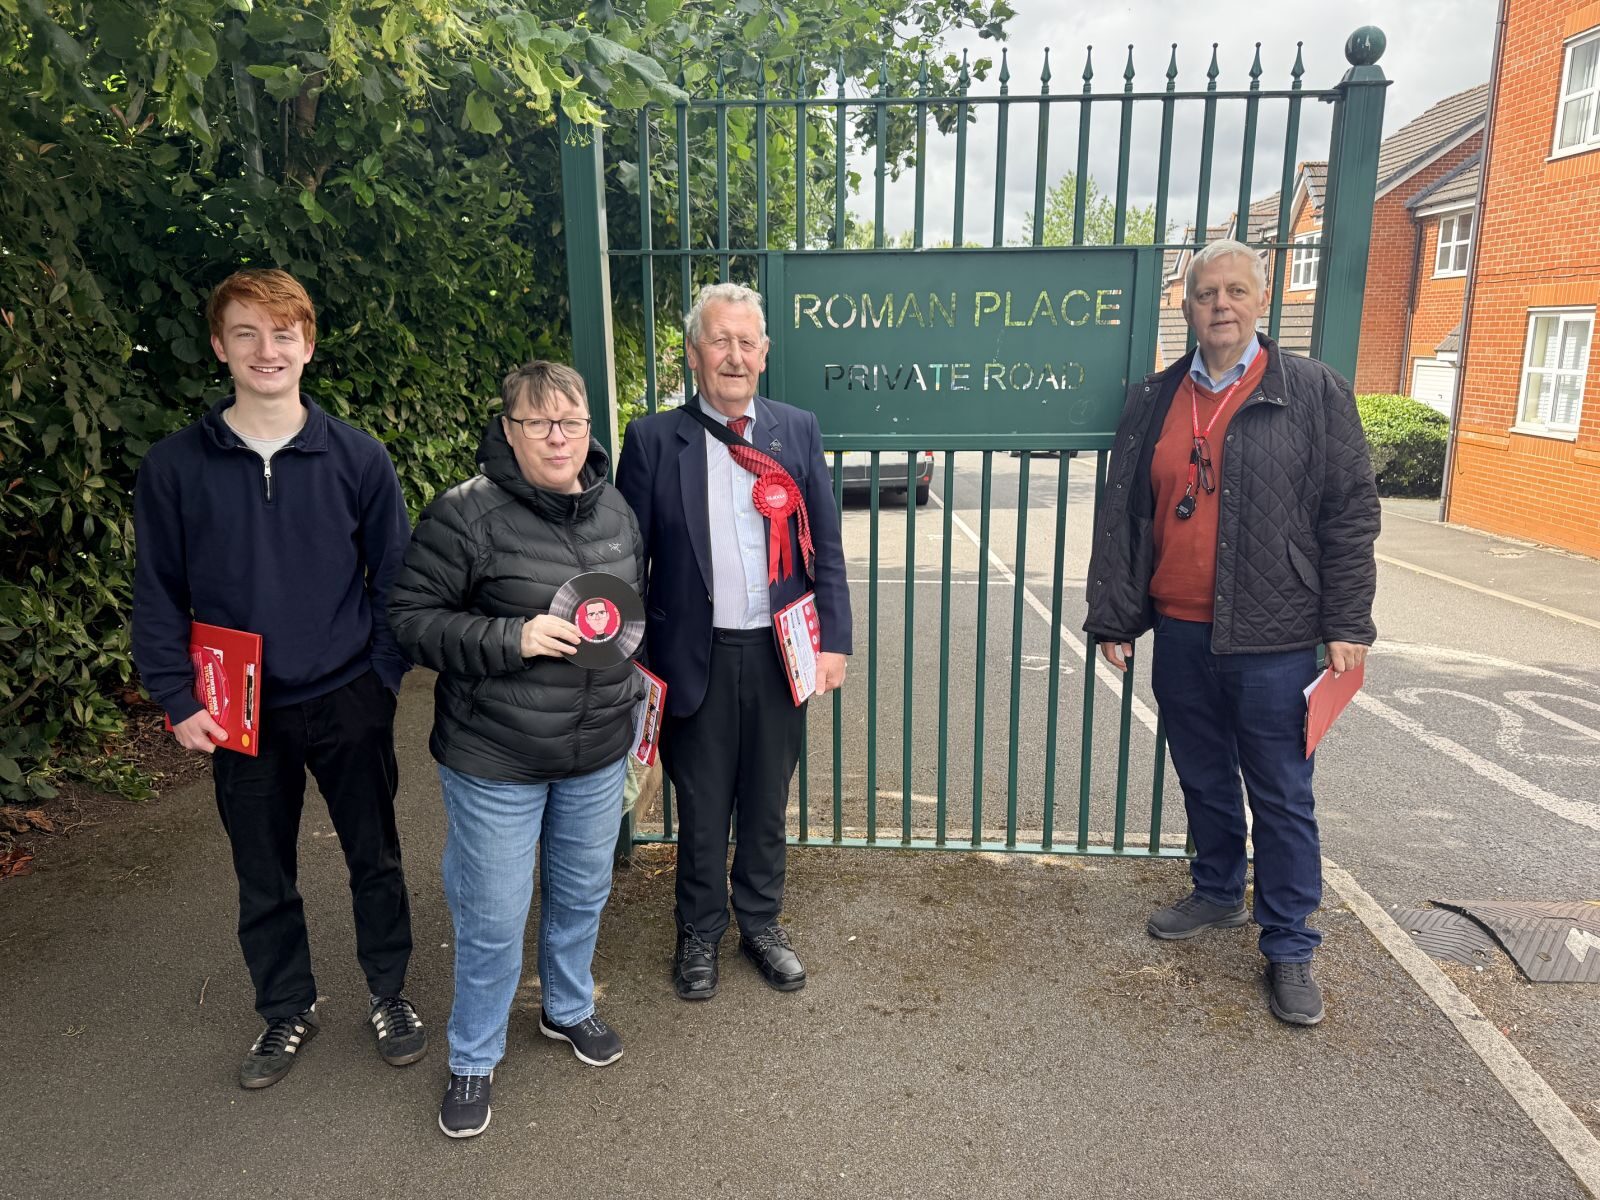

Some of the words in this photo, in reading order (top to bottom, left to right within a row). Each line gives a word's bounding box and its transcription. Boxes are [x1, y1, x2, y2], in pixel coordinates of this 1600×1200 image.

[794, 291, 957, 329] ROMAN
[974, 289, 1122, 327] PLACE
[824, 363, 970, 391] PRIVATE
[984, 362, 1086, 391] ROAD
